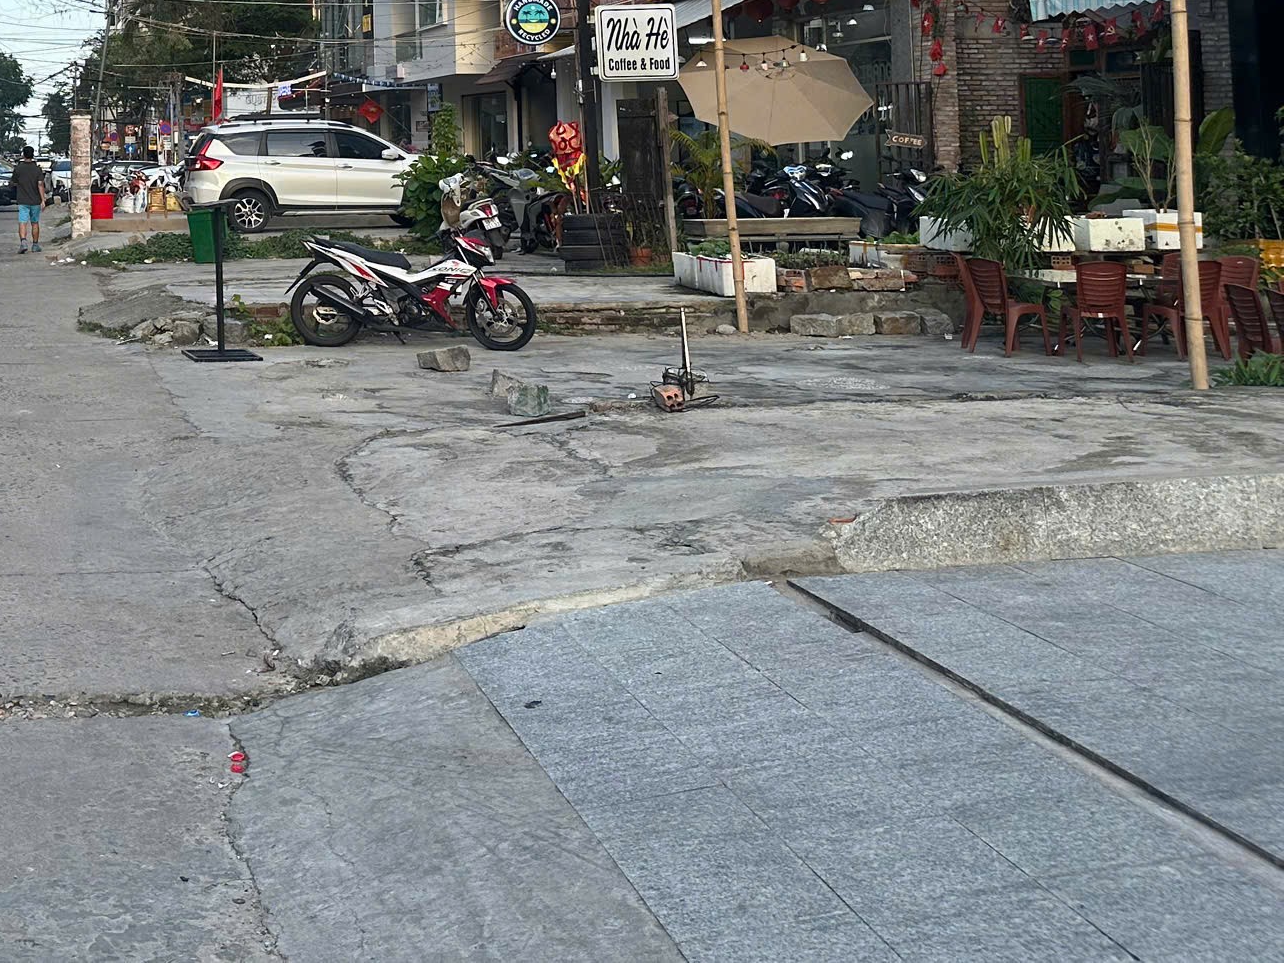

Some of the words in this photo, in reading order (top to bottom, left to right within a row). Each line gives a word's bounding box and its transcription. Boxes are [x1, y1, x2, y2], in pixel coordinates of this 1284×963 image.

[517, 28, 551, 41] RECYCLED
[606, 17, 642, 52] Nhà
[645, 16, 670, 51] Hè
[608, 58, 637, 71] Coffee
[640, 58, 647, 70] &
[650, 57, 670, 70] Food
